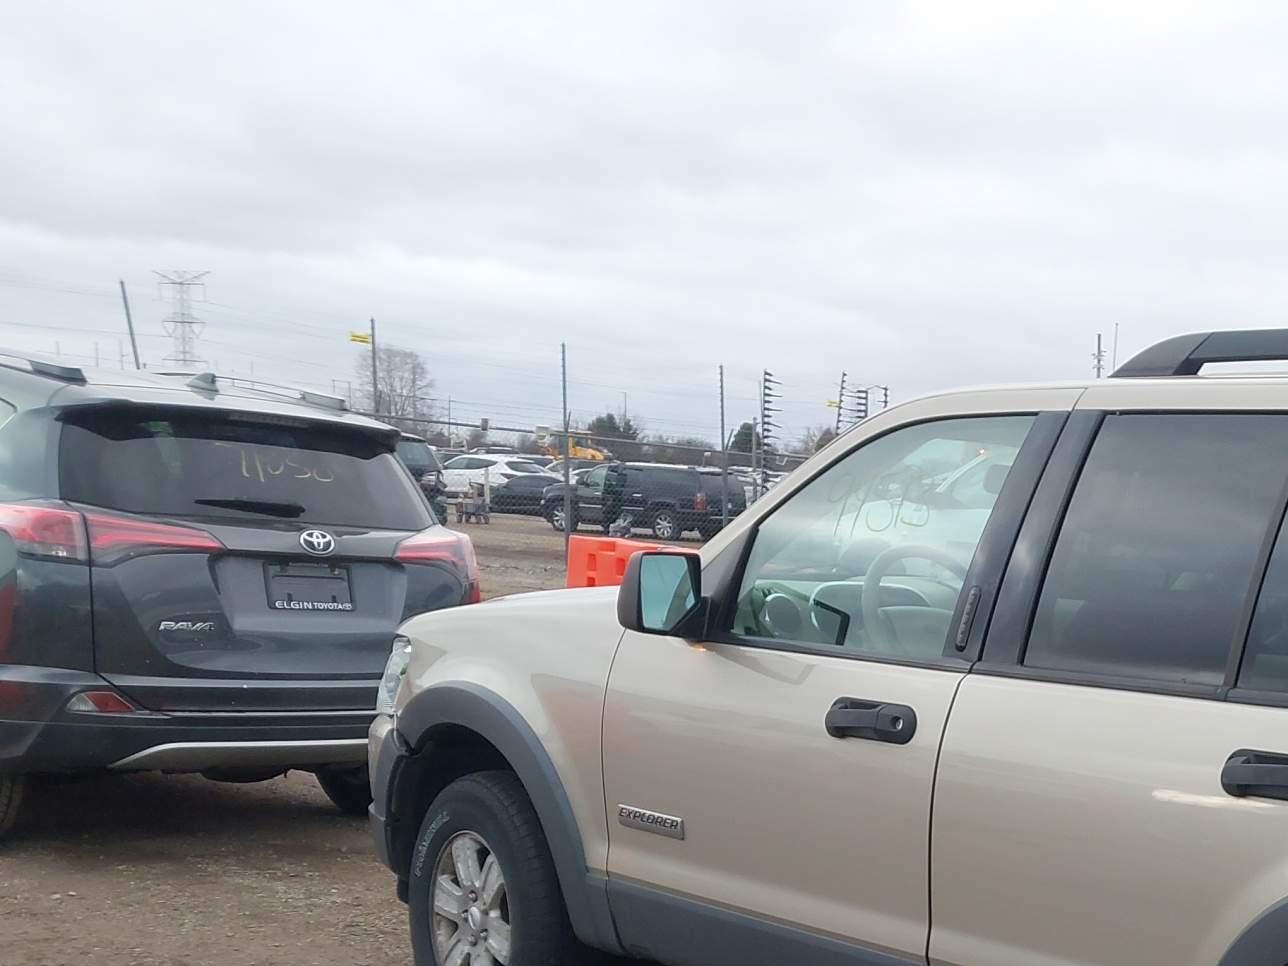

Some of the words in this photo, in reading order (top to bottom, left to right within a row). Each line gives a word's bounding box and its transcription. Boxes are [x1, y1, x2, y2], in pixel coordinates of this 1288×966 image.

[274, 600, 313, 610] ELGIN
[313, 602, 343, 610] TOYOTA
[158, 621, 215, 632] RAV4
[618, 807, 679, 830] EXPLORER
